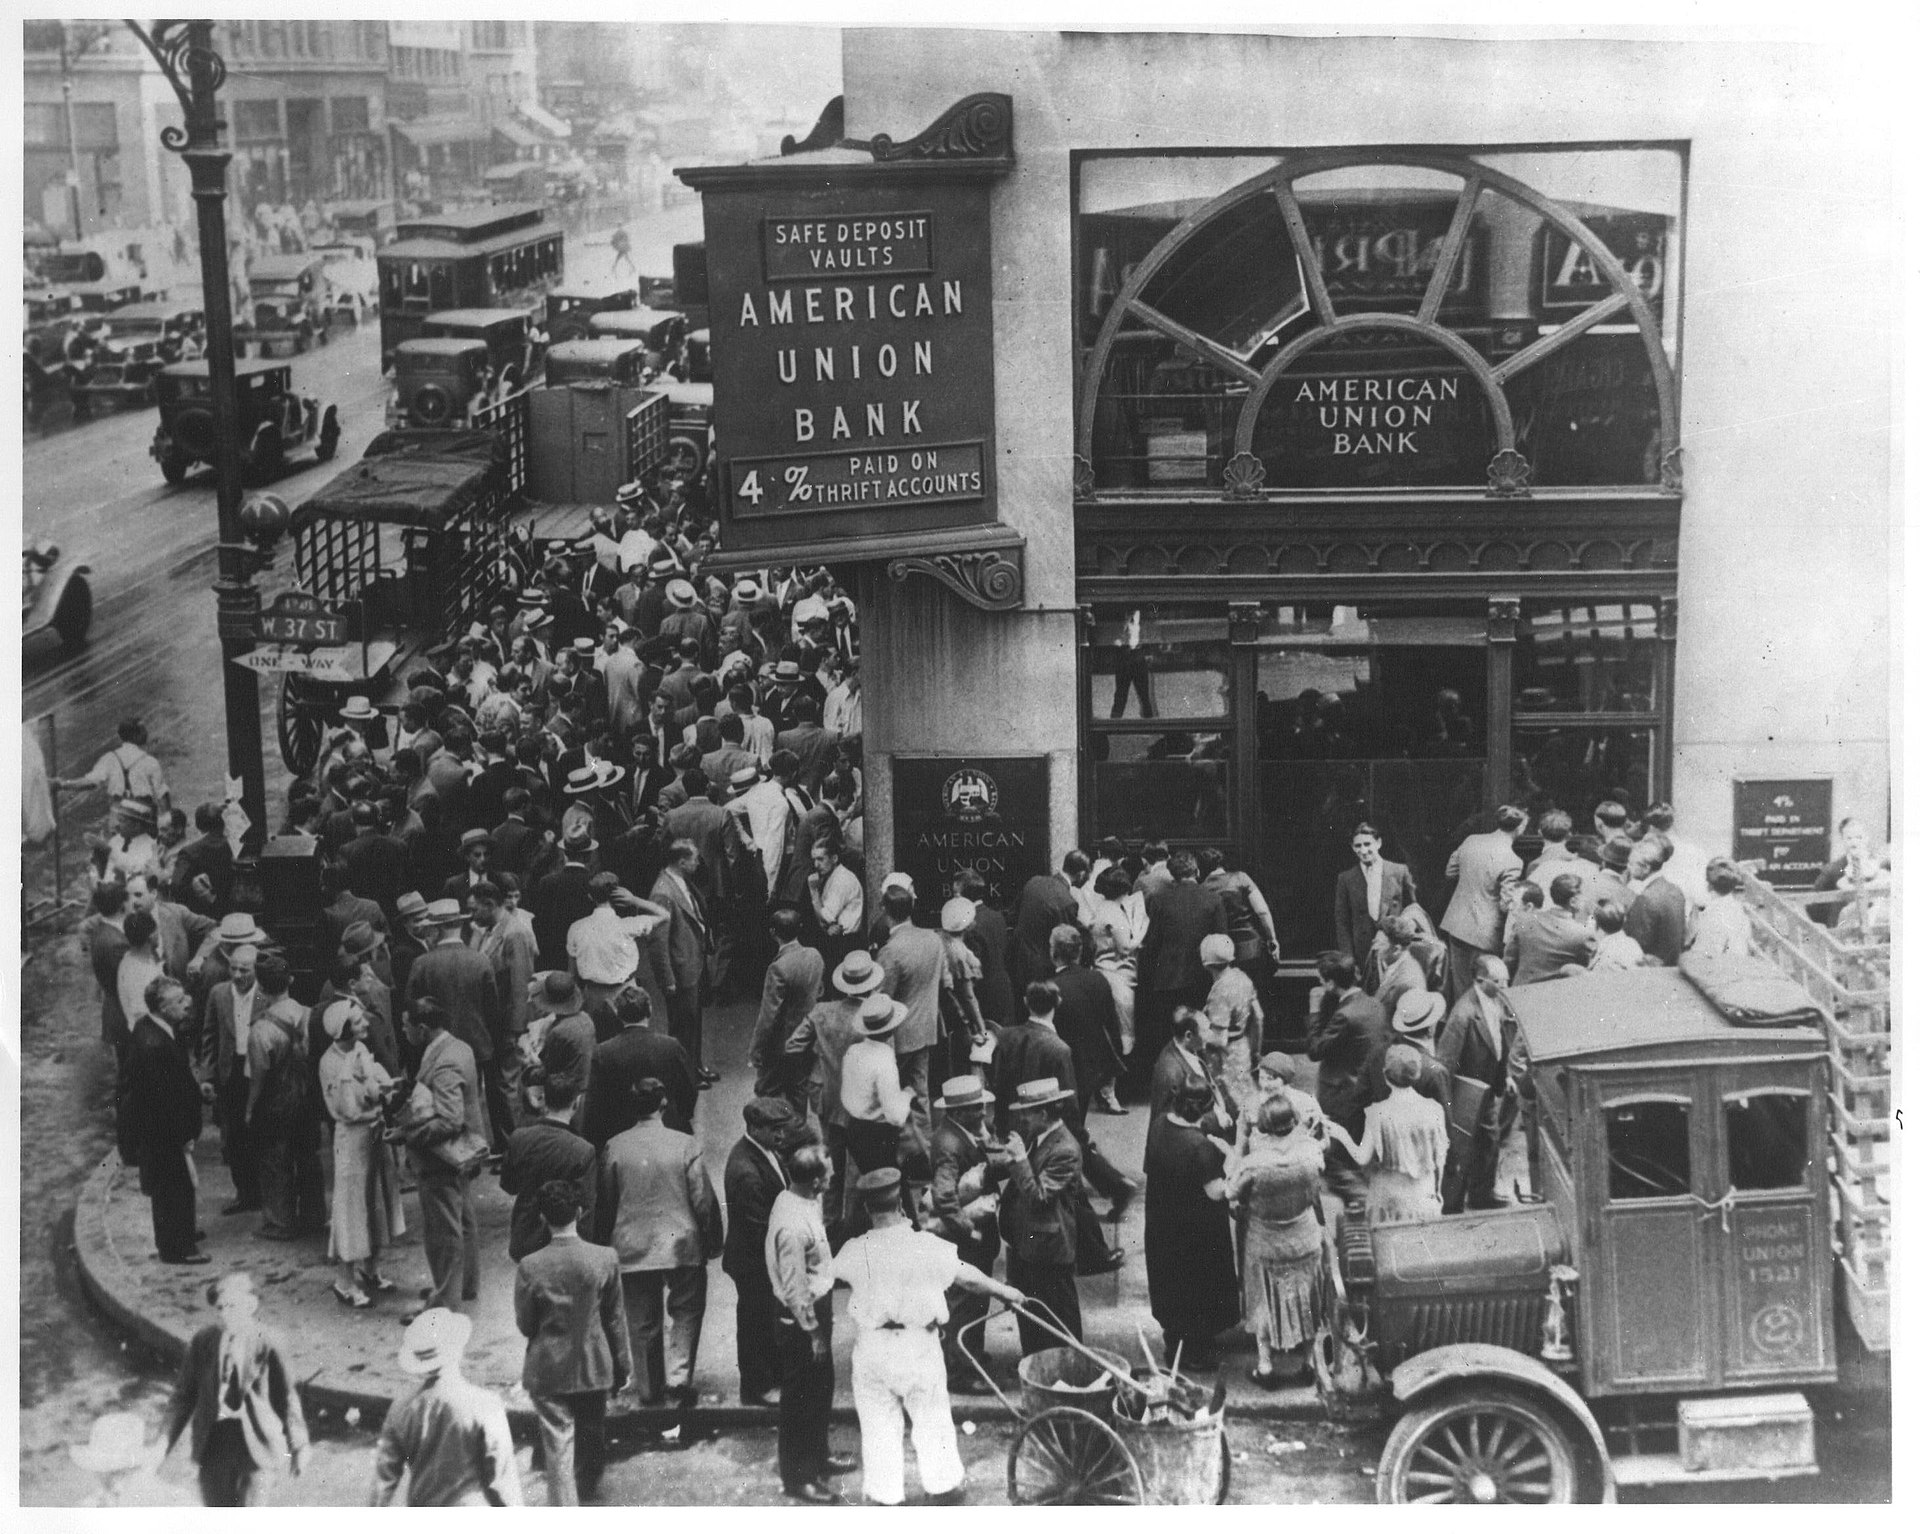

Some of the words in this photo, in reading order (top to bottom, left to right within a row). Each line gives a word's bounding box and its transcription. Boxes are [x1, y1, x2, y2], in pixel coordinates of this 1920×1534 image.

[776, 223, 828, 244] SAFE
[837, 218, 926, 243] DEPOSIT
[810, 246, 893, 269] VAULTS
[740, 280, 963, 328] AMERICAN
[778, 340, 933, 384] UNION
[1294, 377, 1458, 402] AMERICAN
[795, 400, 923, 443] BANK
[1319, 404, 1432, 428] UNION
[1333, 431, 1419, 455] BANK
[850, 455, 899, 476] PAID
[911, 451, 938, 470] ON
[815, 480, 882, 504] THRIFT
[887, 471, 982, 498] ACCOUNTS
[285, 618, 308, 639] 37
[917, 831, 1025, 849] AMERICAN
[942, 882, 1001, 898] BK
[1742, 1243, 1805, 1262] UNION
